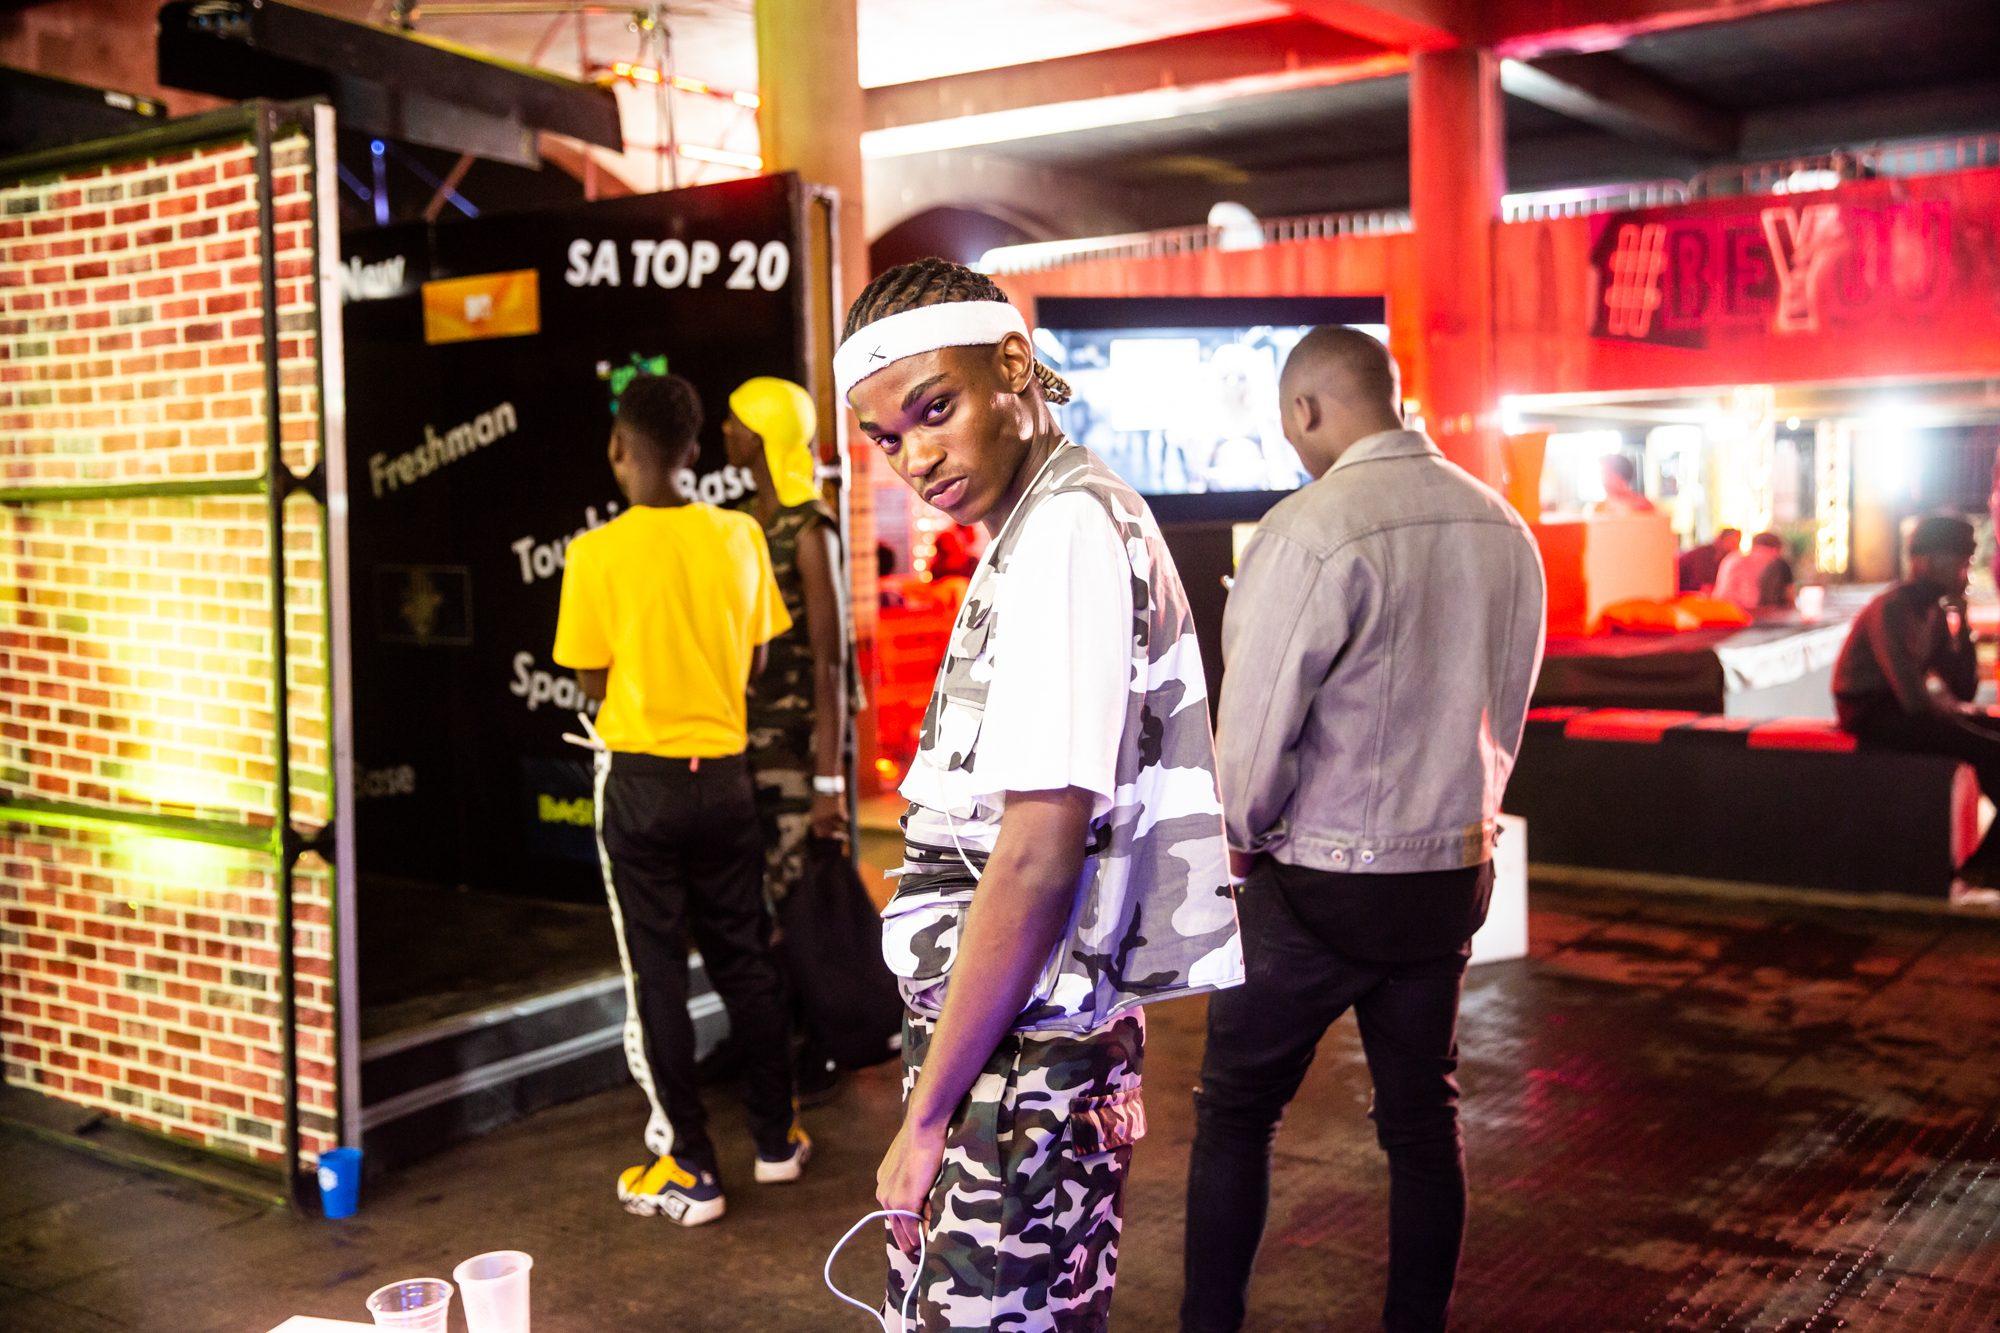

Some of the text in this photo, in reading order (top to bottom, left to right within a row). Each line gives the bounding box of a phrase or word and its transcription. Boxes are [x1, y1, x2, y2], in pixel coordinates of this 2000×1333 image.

[564, 238, 790, 292] SA TOP 20
[369, 402, 518, 498] Freshman
